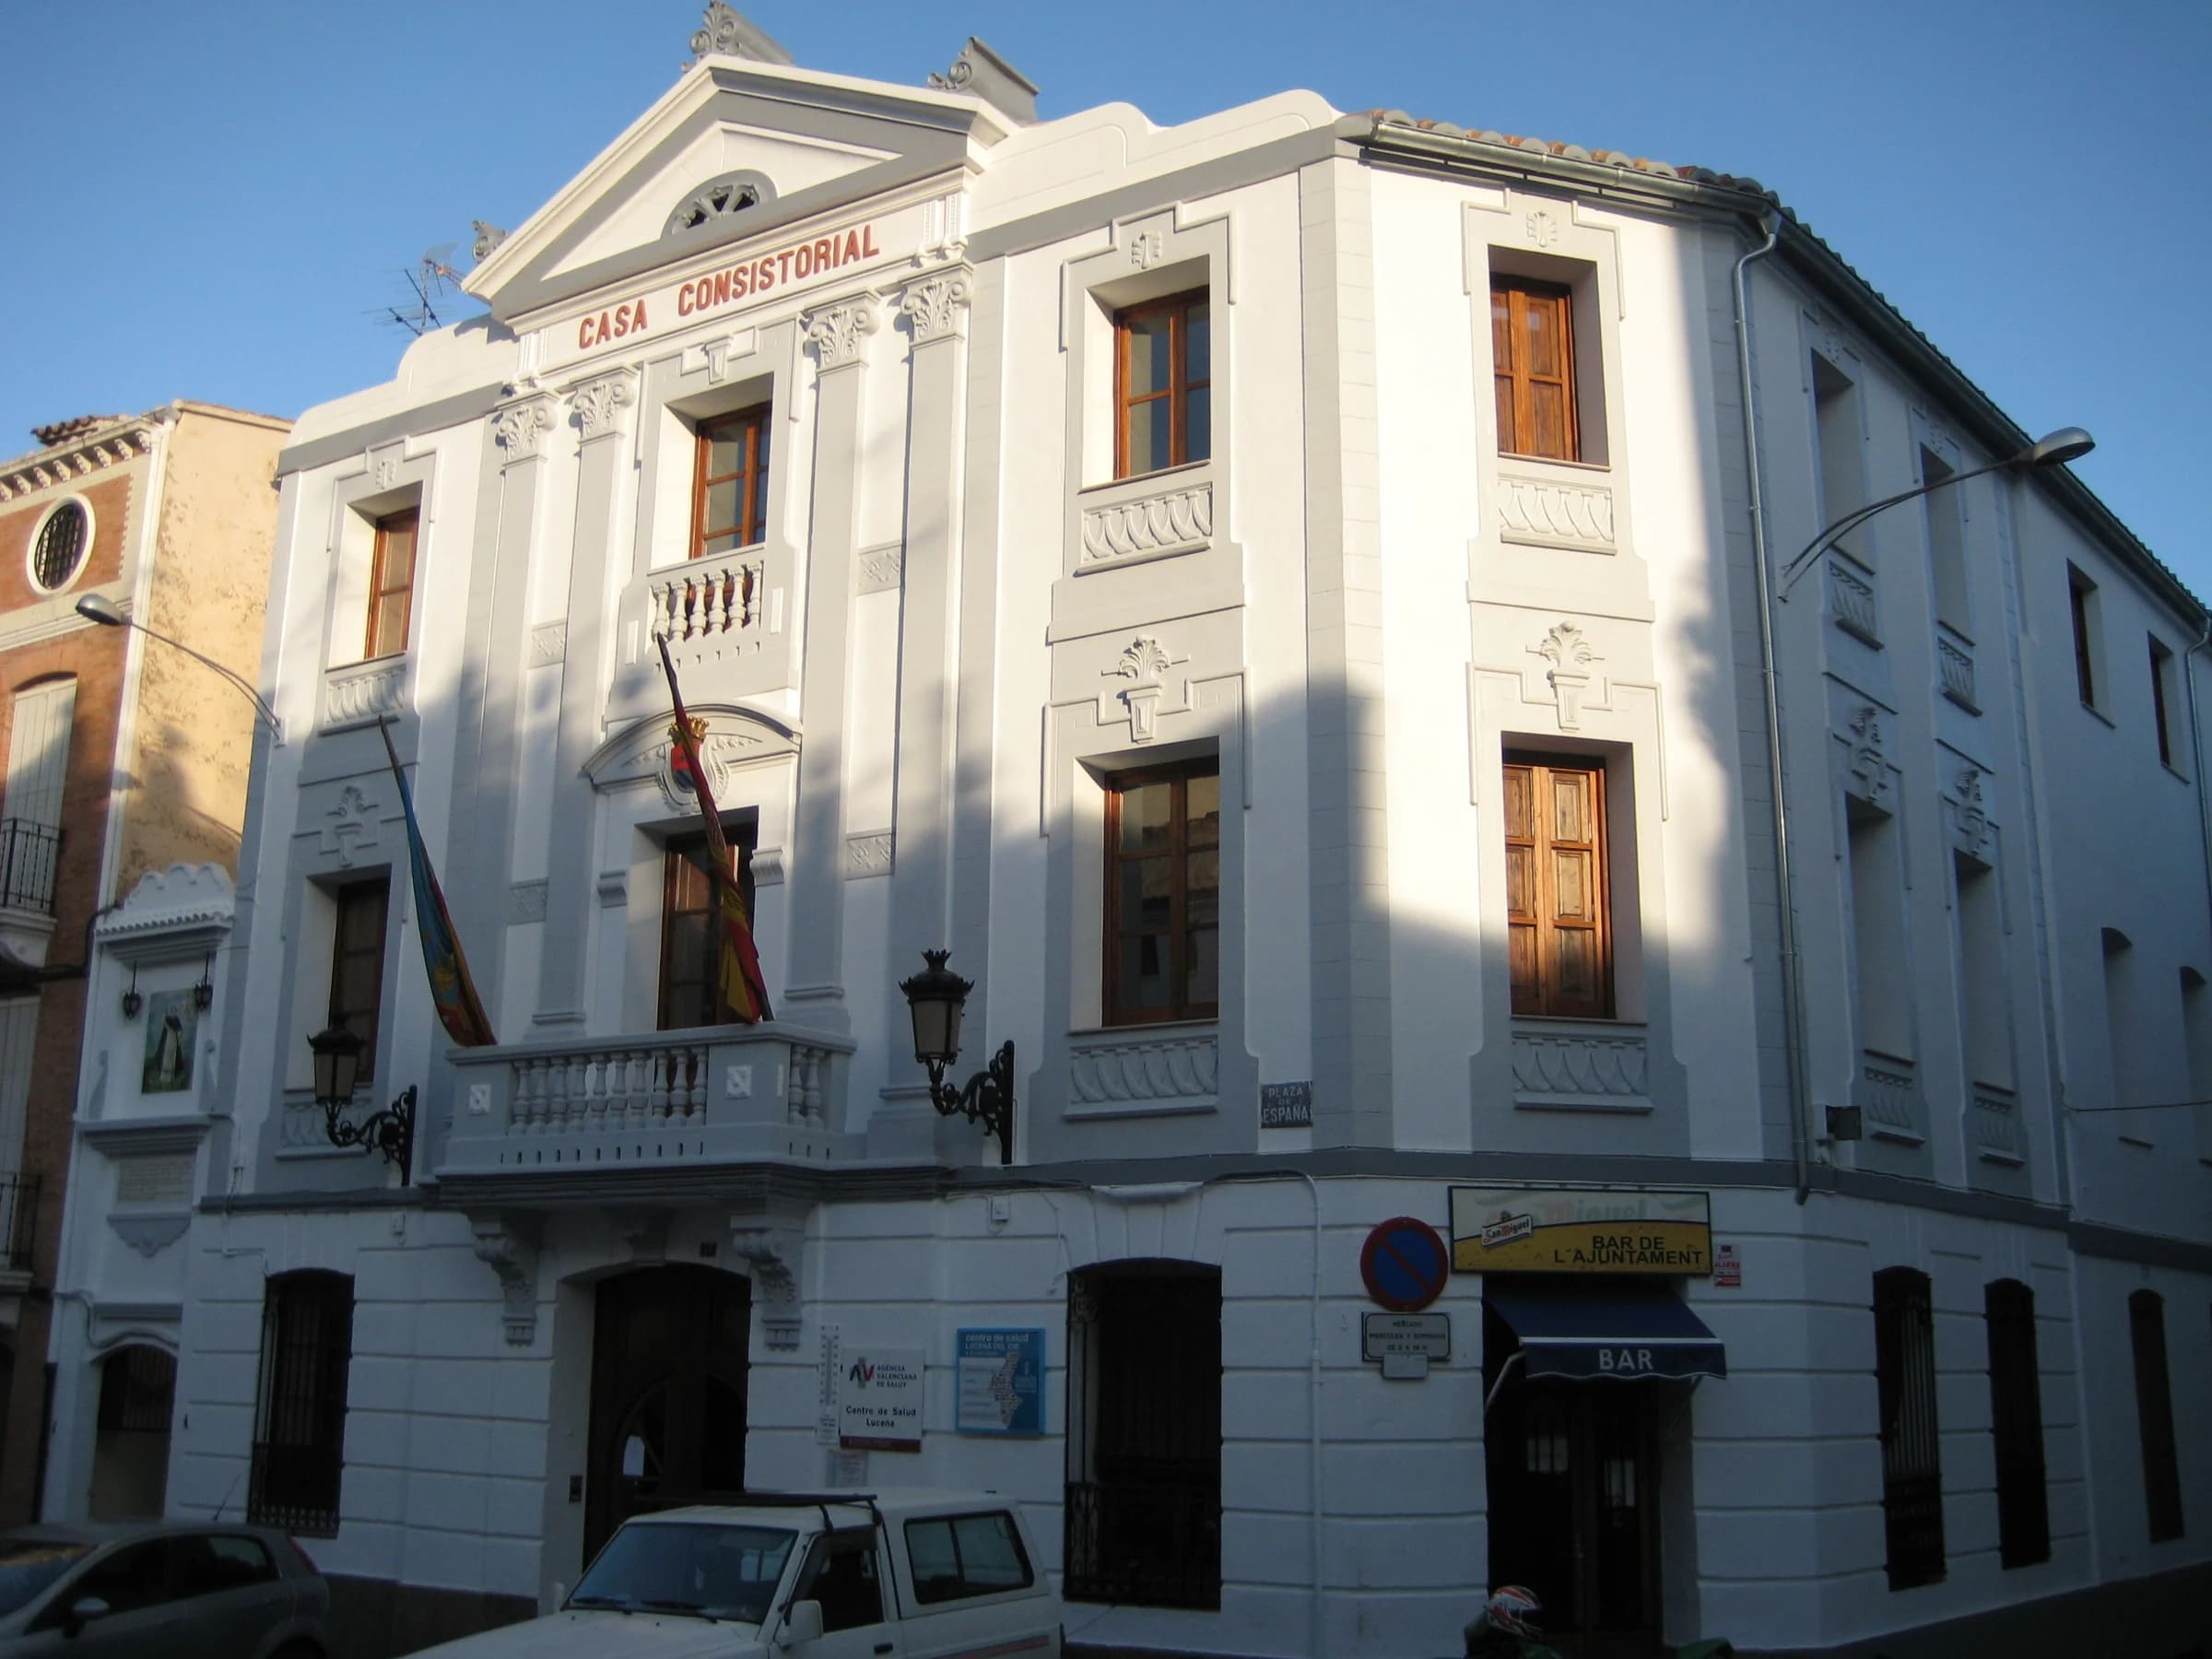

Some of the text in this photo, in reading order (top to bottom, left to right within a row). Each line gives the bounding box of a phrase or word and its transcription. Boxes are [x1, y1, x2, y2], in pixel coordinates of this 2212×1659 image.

[579, 225, 880, 349] CASA CONSISTORIAL
[1268, 1086, 1303, 1098] PLAZA
[1263, 1105, 1309, 1123] ESPAÑA
[1500, 1218, 1530, 1238] Miguel
[1592, 1235, 1665, 1251] BAR DE
[1599, 1348, 1654, 1371] BAR
[877, 1406, 888, 1415] de
[892, 1406, 916, 1416] Salud
[865, 1418, 895, 1427] Lucena
